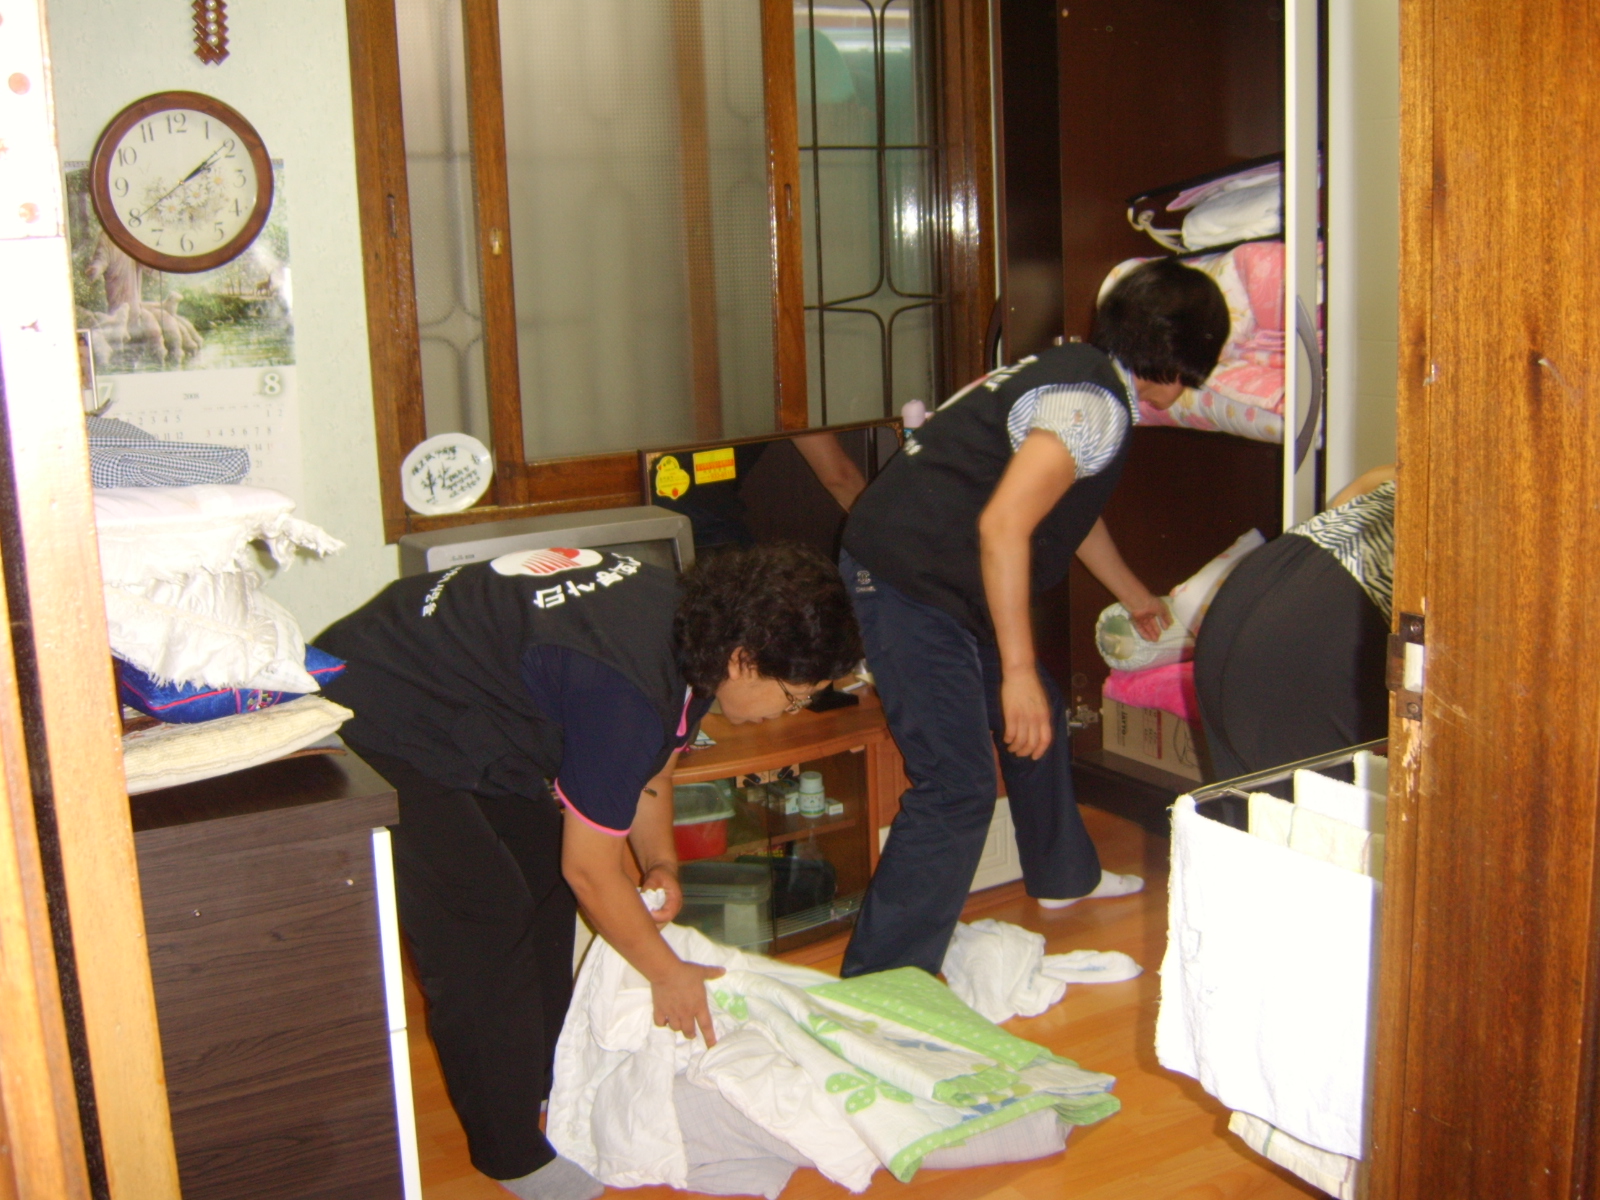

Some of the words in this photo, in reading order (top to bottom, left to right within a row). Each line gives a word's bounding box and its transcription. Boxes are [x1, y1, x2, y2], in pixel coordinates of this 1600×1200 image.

[140, 121, 154, 143] 11
[166, 112, 187, 134] 12
[117, 146, 138, 167] 10
[222, 138, 236, 158] 2
[114, 176, 129, 198] 9
[232, 169, 247, 189] 3
[128, 207, 142, 229] 8
[228, 198, 243, 217] 4
[151, 228, 164, 247] 7
[212, 221, 225, 242] 5
[180, 233, 194, 253] 6
[264, 373, 281, 395] 8
[176, 432, 183, 440] 12
